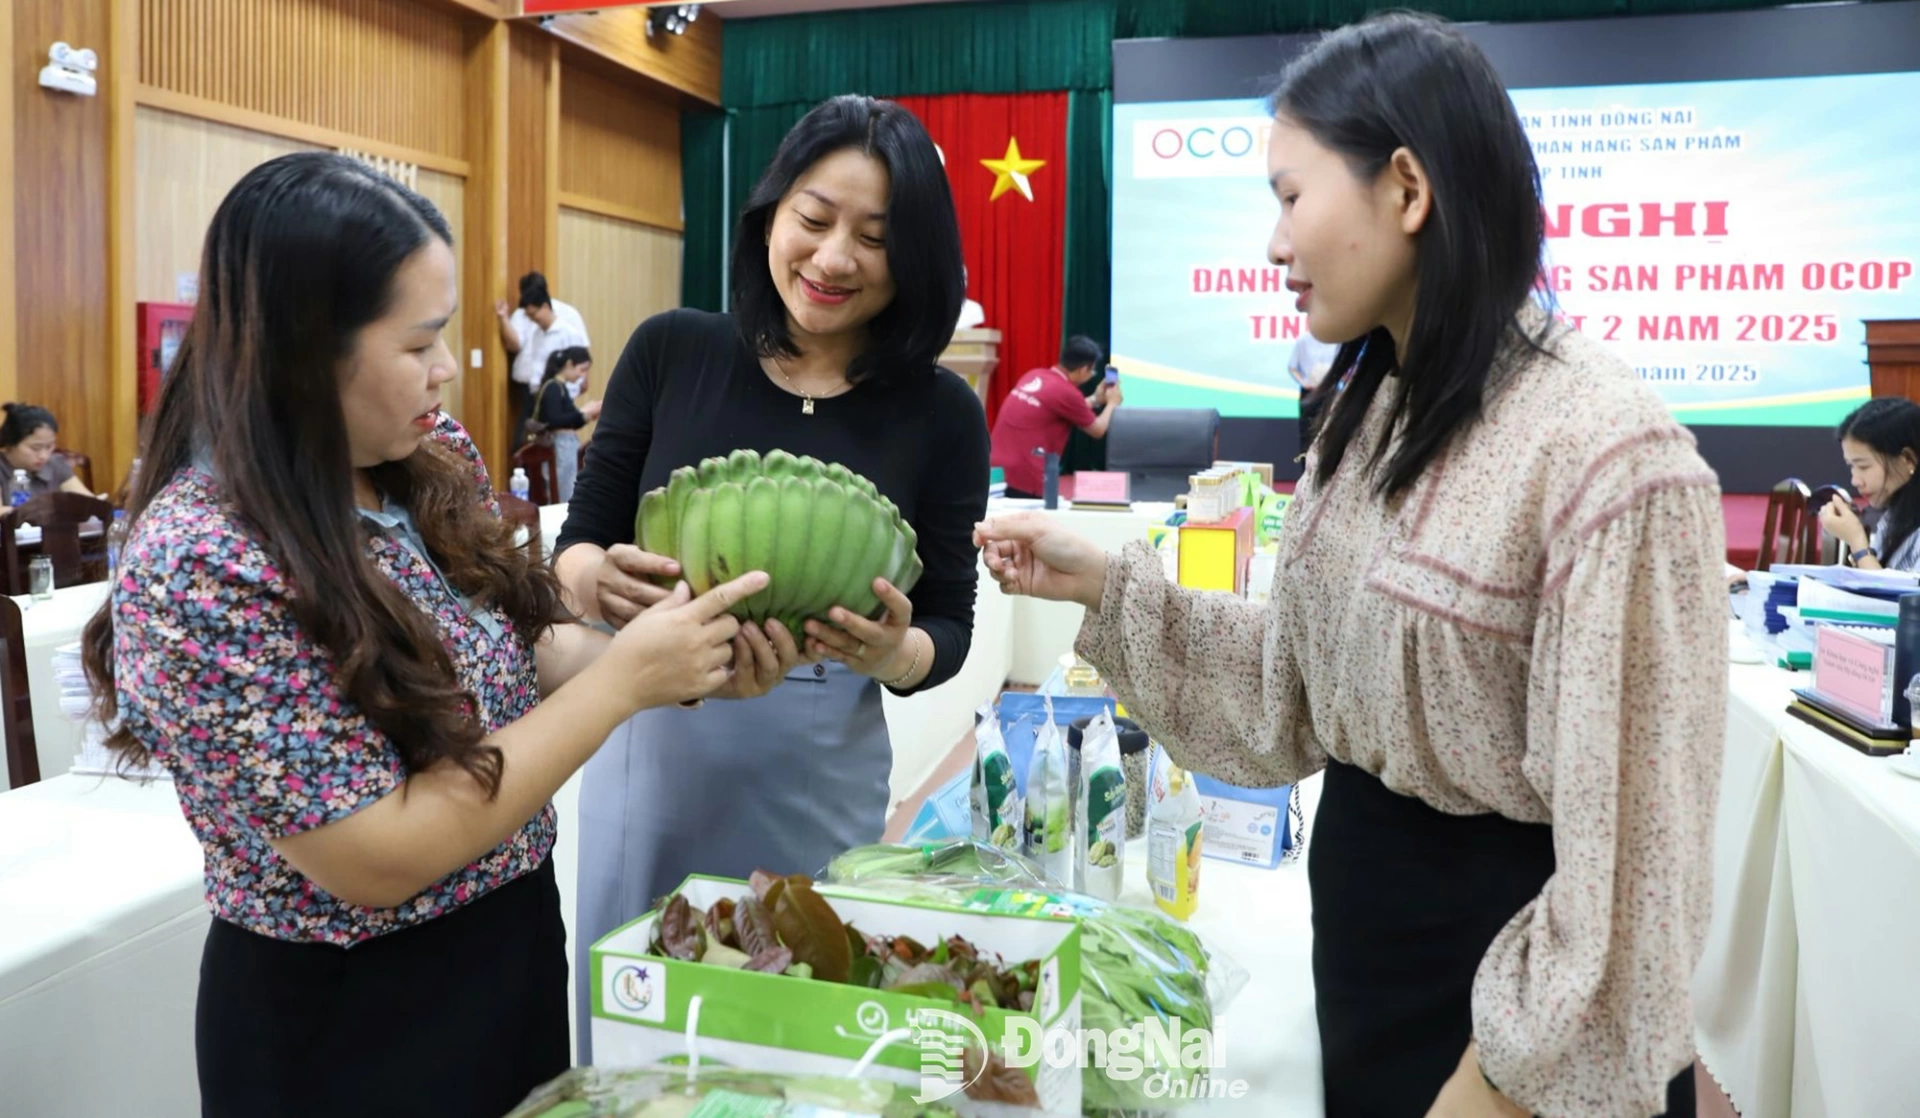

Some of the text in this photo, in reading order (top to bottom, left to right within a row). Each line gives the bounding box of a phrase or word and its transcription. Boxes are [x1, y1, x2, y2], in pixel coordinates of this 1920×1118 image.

[1660, 110, 1692, 125] NAI
[1801, 260, 1912, 291] OCOP
[1602, 314, 1621, 341] 2
[1735, 313, 1838, 342] 2025
[1695, 363, 1757, 381] 2025
